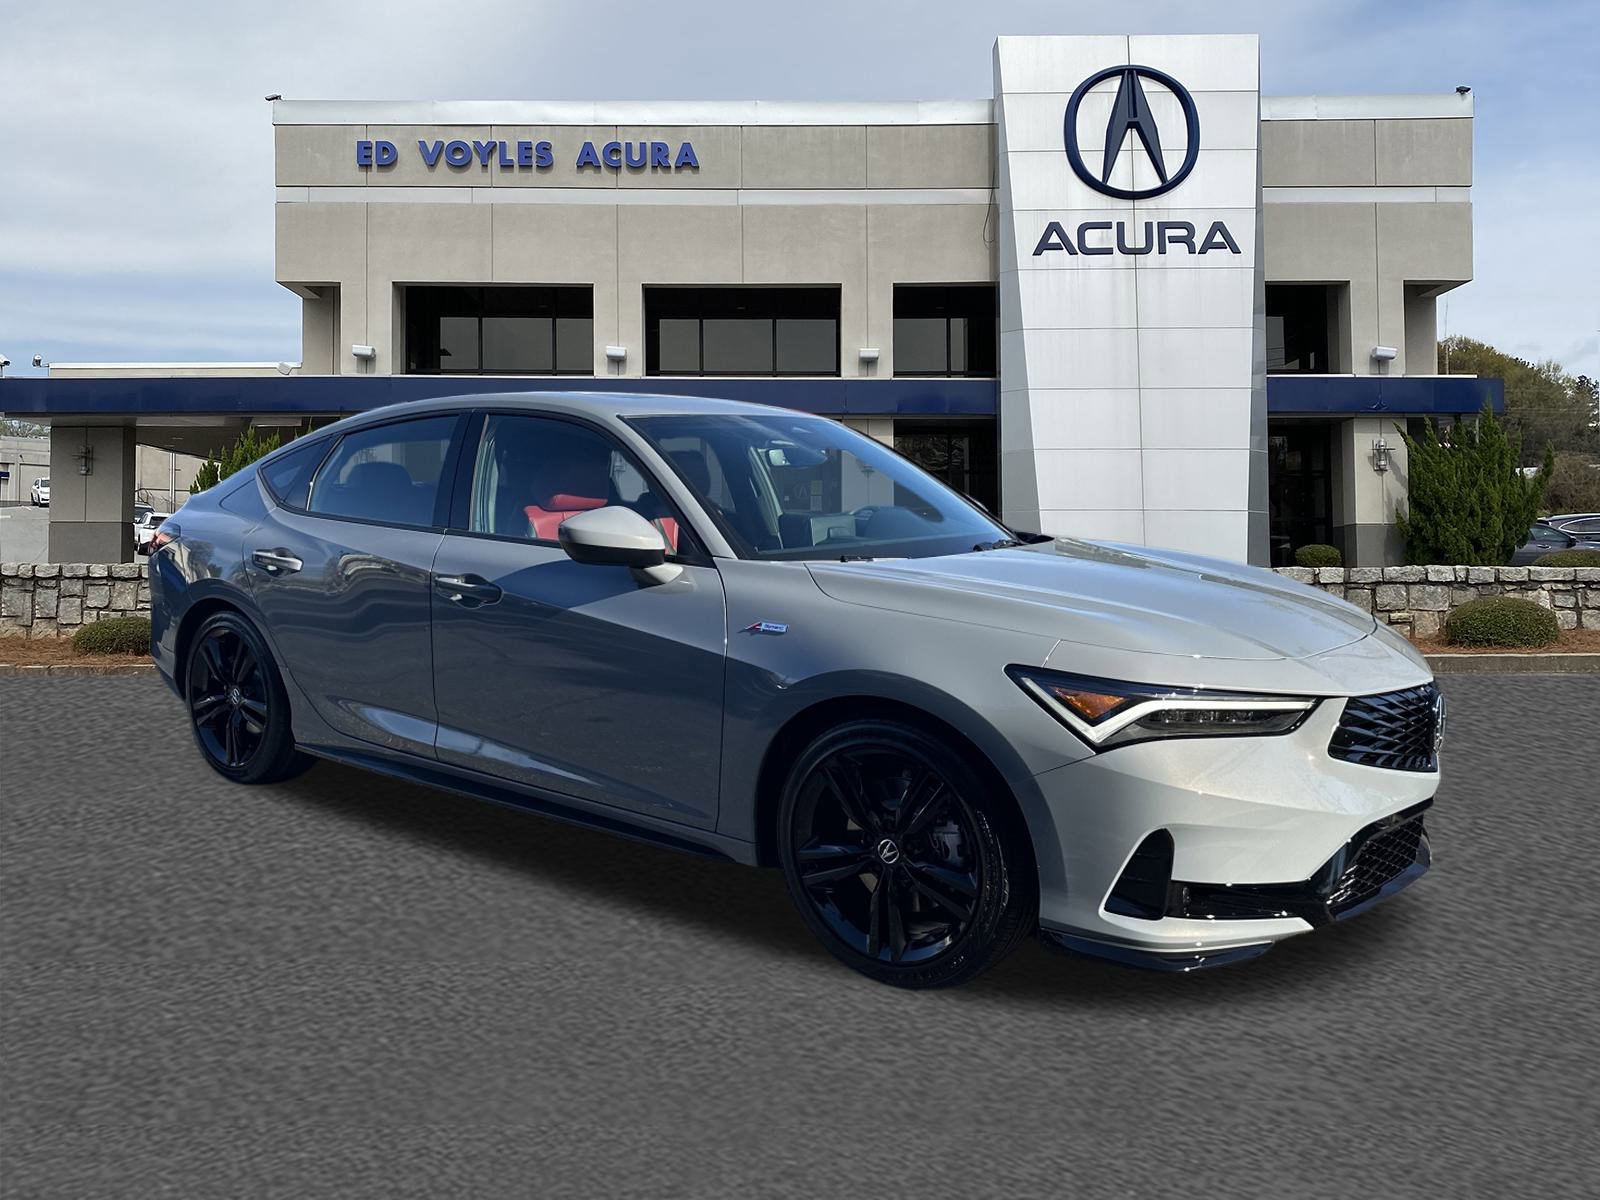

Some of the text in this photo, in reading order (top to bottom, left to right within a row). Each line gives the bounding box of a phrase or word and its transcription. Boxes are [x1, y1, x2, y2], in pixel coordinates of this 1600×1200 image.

[356, 140, 700, 168] ED VOYLES ACURA
[1032, 221, 1242, 256] ACURA
